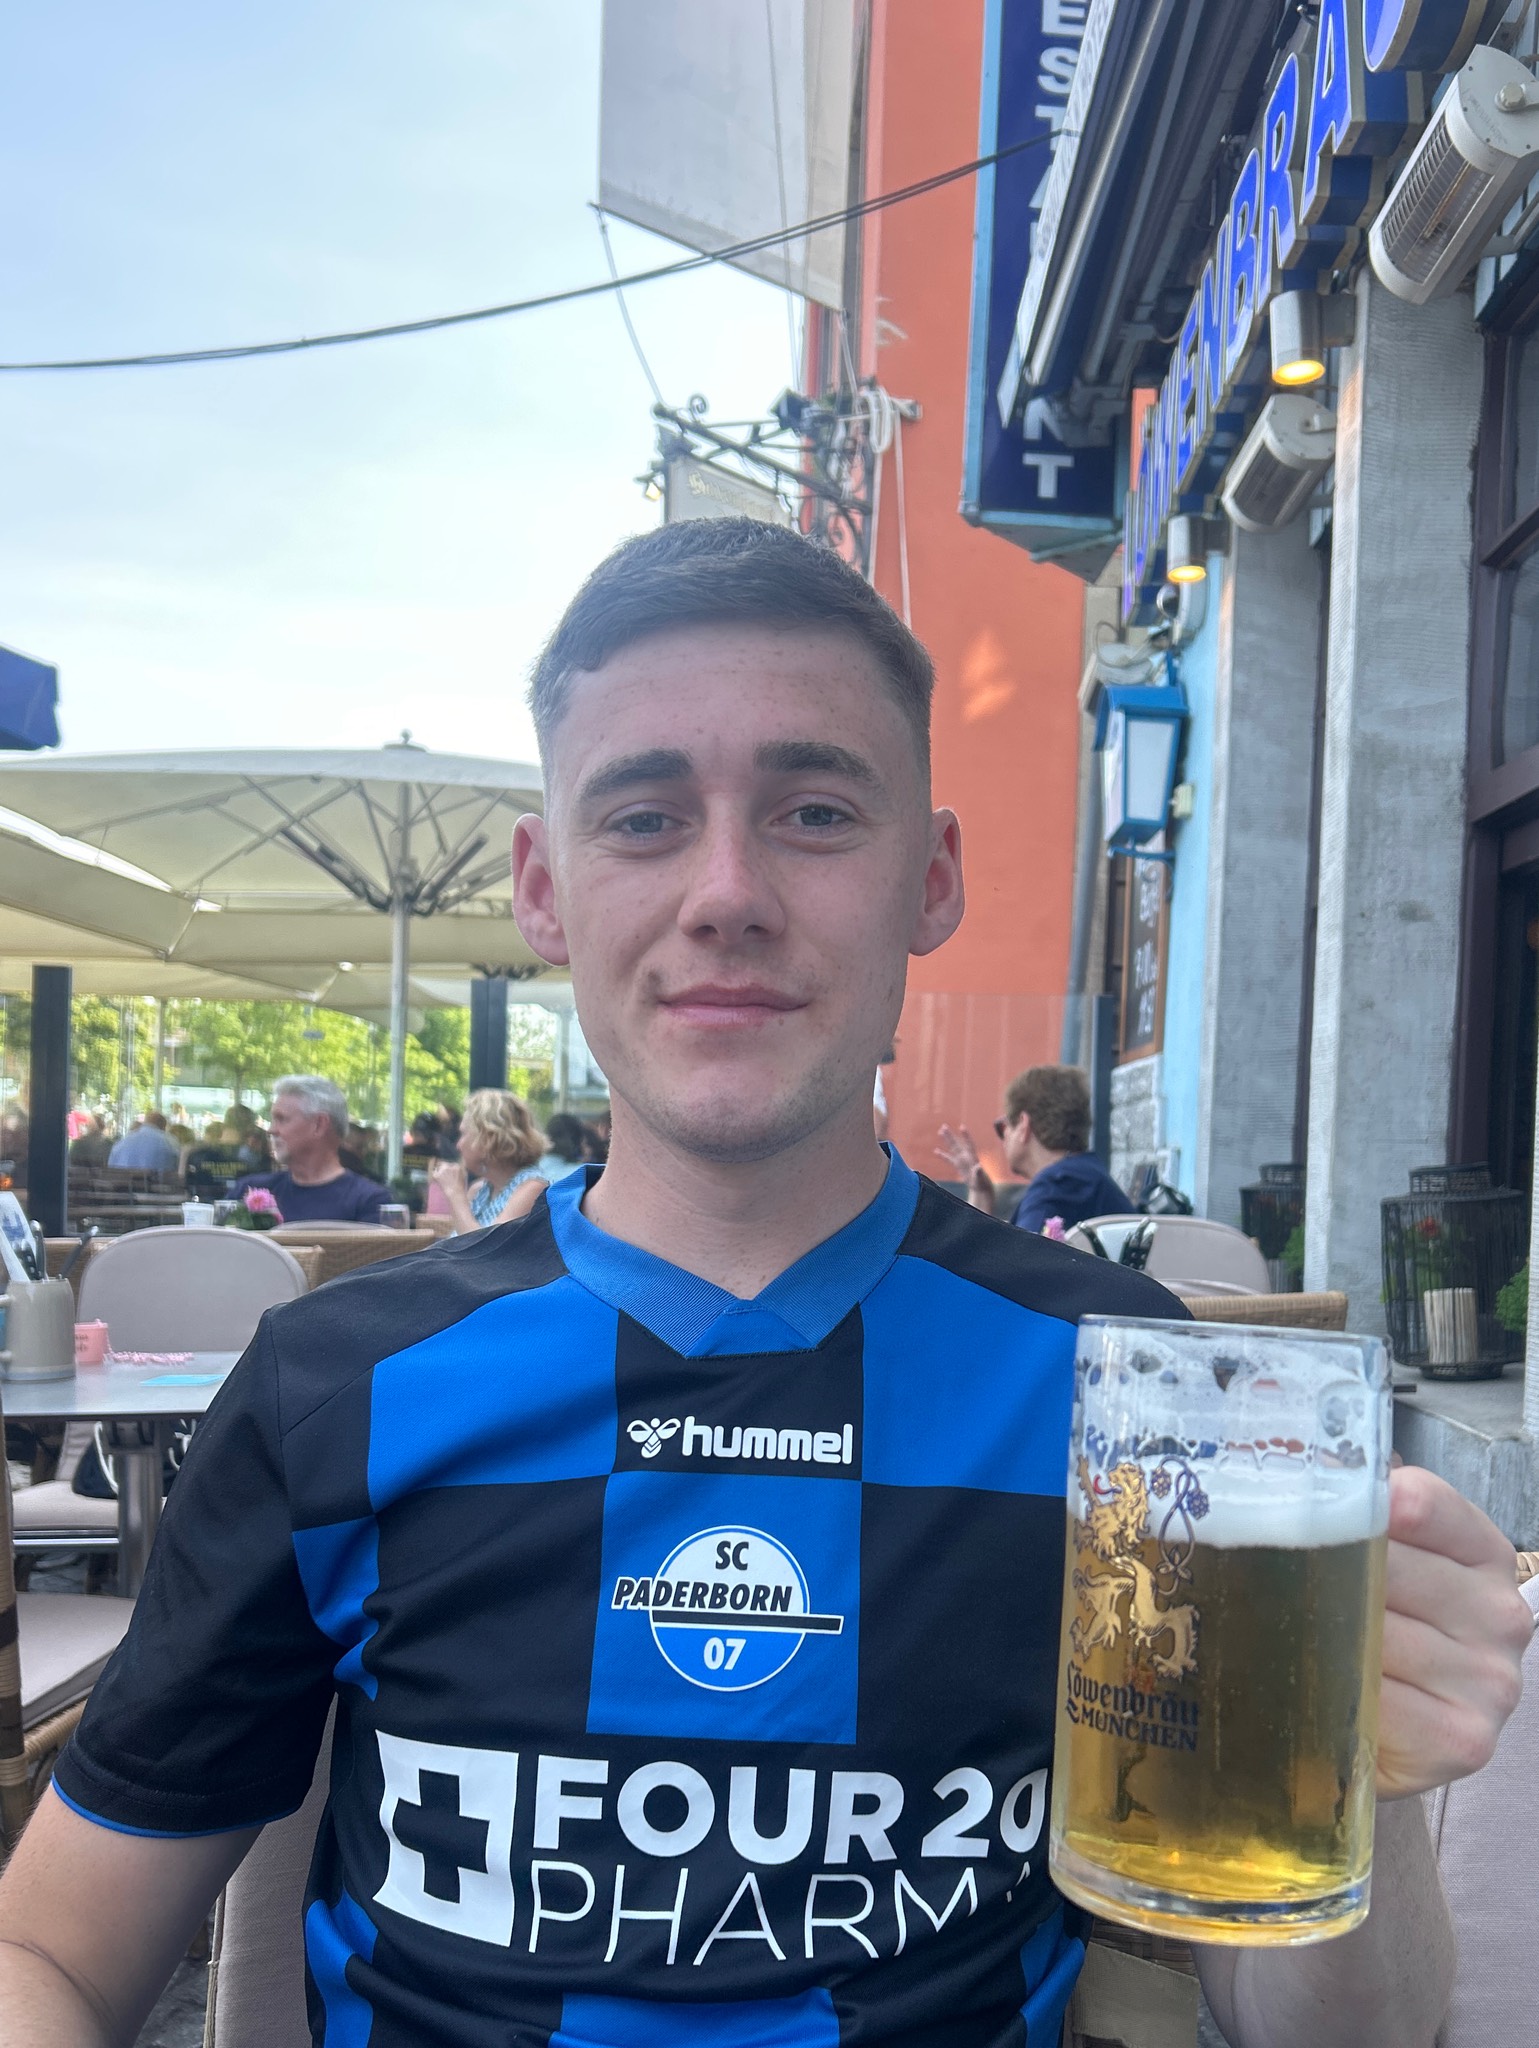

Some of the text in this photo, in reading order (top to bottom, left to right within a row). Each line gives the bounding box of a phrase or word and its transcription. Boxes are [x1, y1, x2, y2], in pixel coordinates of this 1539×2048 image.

[682, 1415, 854, 1465] hummel
[715, 1540, 749, 1571] SC
[613, 1578, 793, 1613] PADERBORN
[703, 1636, 747, 1671] 07
[532, 1754, 1049, 1865] FOUR 20
[528, 1859, 1031, 1966] PHARM
